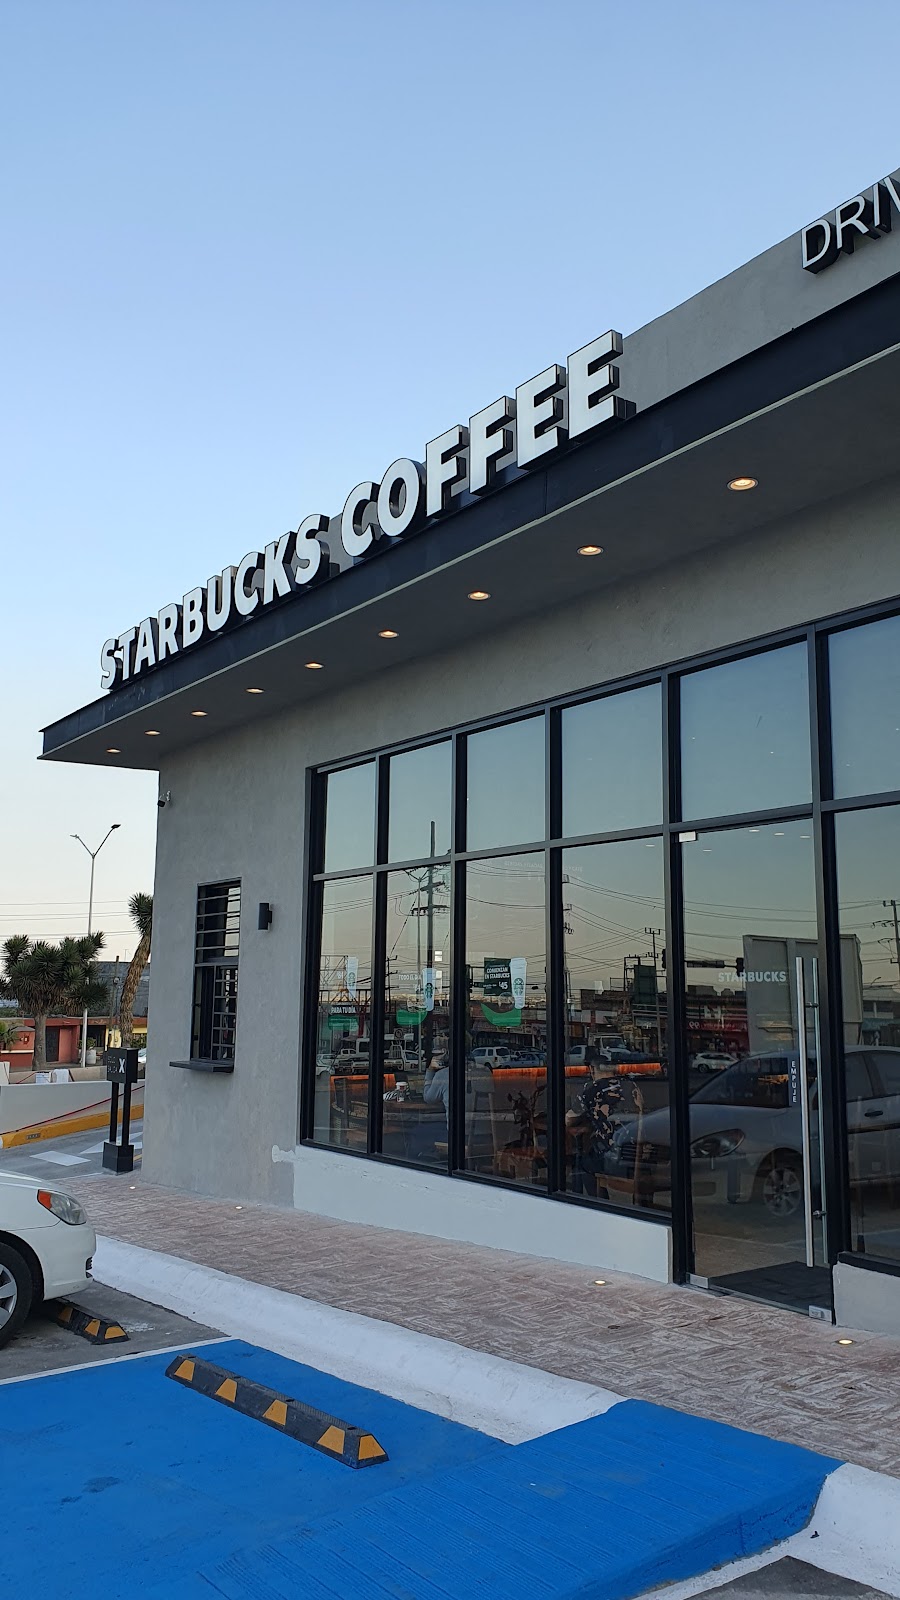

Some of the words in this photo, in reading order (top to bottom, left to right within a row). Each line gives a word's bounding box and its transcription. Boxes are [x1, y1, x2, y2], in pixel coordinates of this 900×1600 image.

[101, 514, 332, 689] STARBUCKS
[341, 330, 624, 558] COFFEE
[718, 971, 787, 982] STARBUCKS
